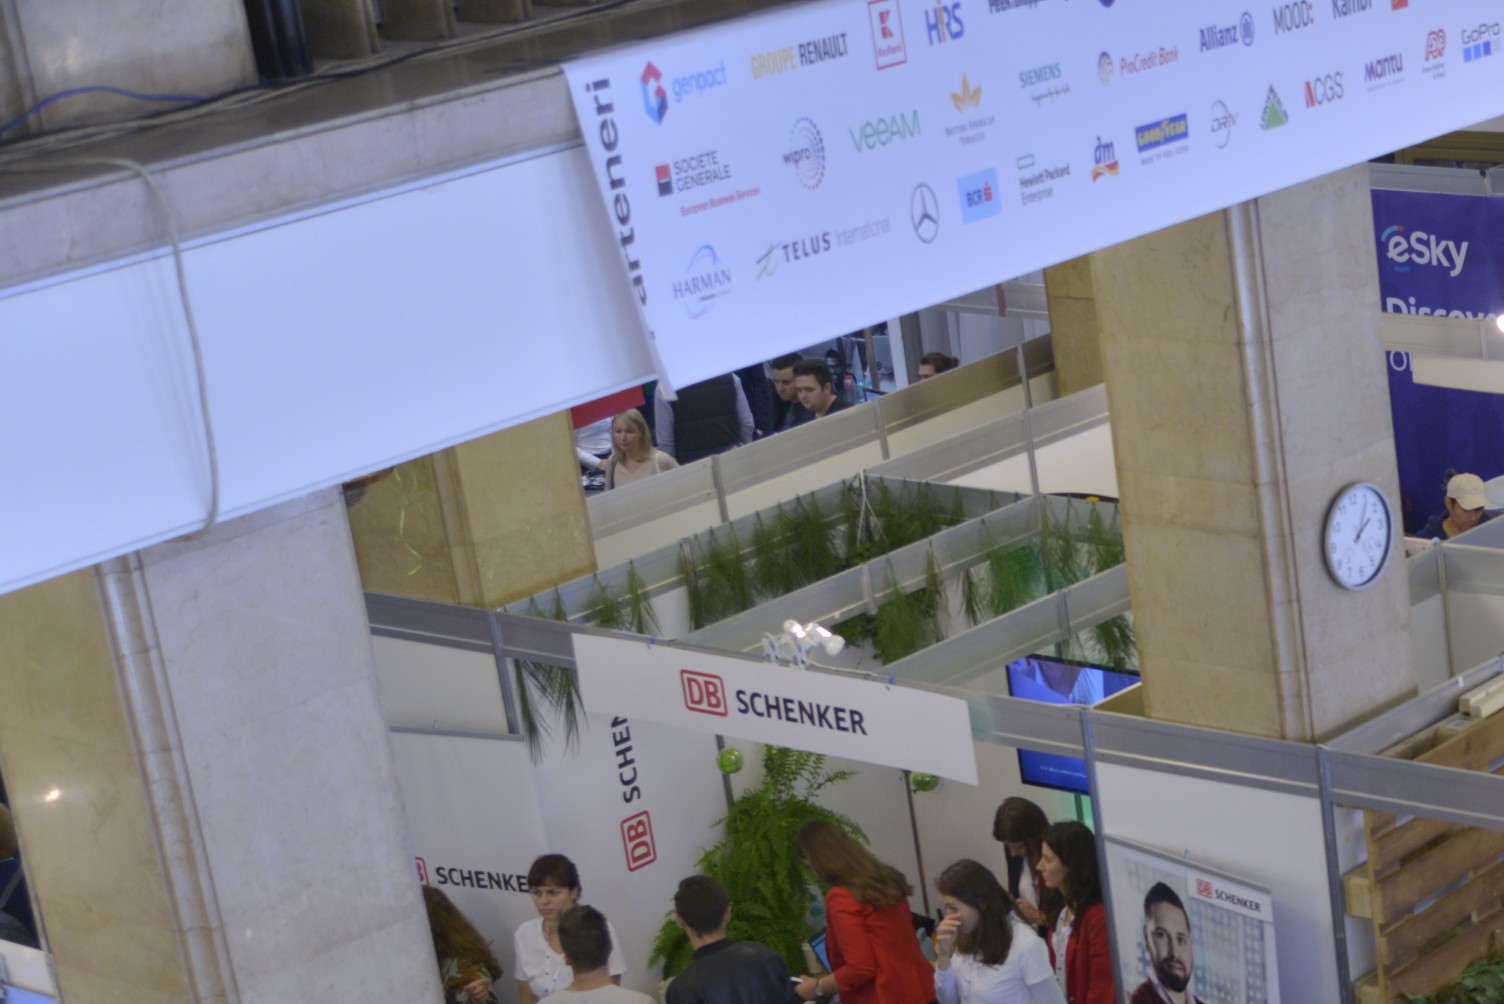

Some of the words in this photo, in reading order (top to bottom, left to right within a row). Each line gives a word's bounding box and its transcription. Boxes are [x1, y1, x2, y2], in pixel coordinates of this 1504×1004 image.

[925, 0, 964, 46] HRS
[1200, 25, 1238, 53] Allianz
[1462, 22, 1500, 46] GoPro
[750, 47, 798, 79] GROUPE
[798, 33, 848, 67] RENAULT
[1120, 52, 1157, 77] ProCredit
[1158, 44, 1179, 67] Bank
[672, 60, 726, 103] genpact
[1019, 62, 1062, 89] SIEMENS
[1313, 71, 1345, 106] CGS
[674, 151, 719, 175] SOCIETE
[782, 147, 811, 167] wipro
[676, 165, 732, 192] GENERALE
[1019, 172, 1044, 190] Hewlett
[1045, 163, 1071, 181] Packard
[585, 79, 656, 340] arteneri
[966, 190, 983, 208] BCR
[782, 232, 832, 264] TELUS
[835, 215, 892, 249] International
[1387, 230, 1469, 277] eSky
[672, 267, 732, 300] HARMAN
[685, 676, 722, 710] DB
[736, 689, 868, 735] SCHENKER
[626, 818, 652, 864] DB
[436, 866, 531, 893] SCHENKE
[1215, 888, 1262, 912] SCHENKER
